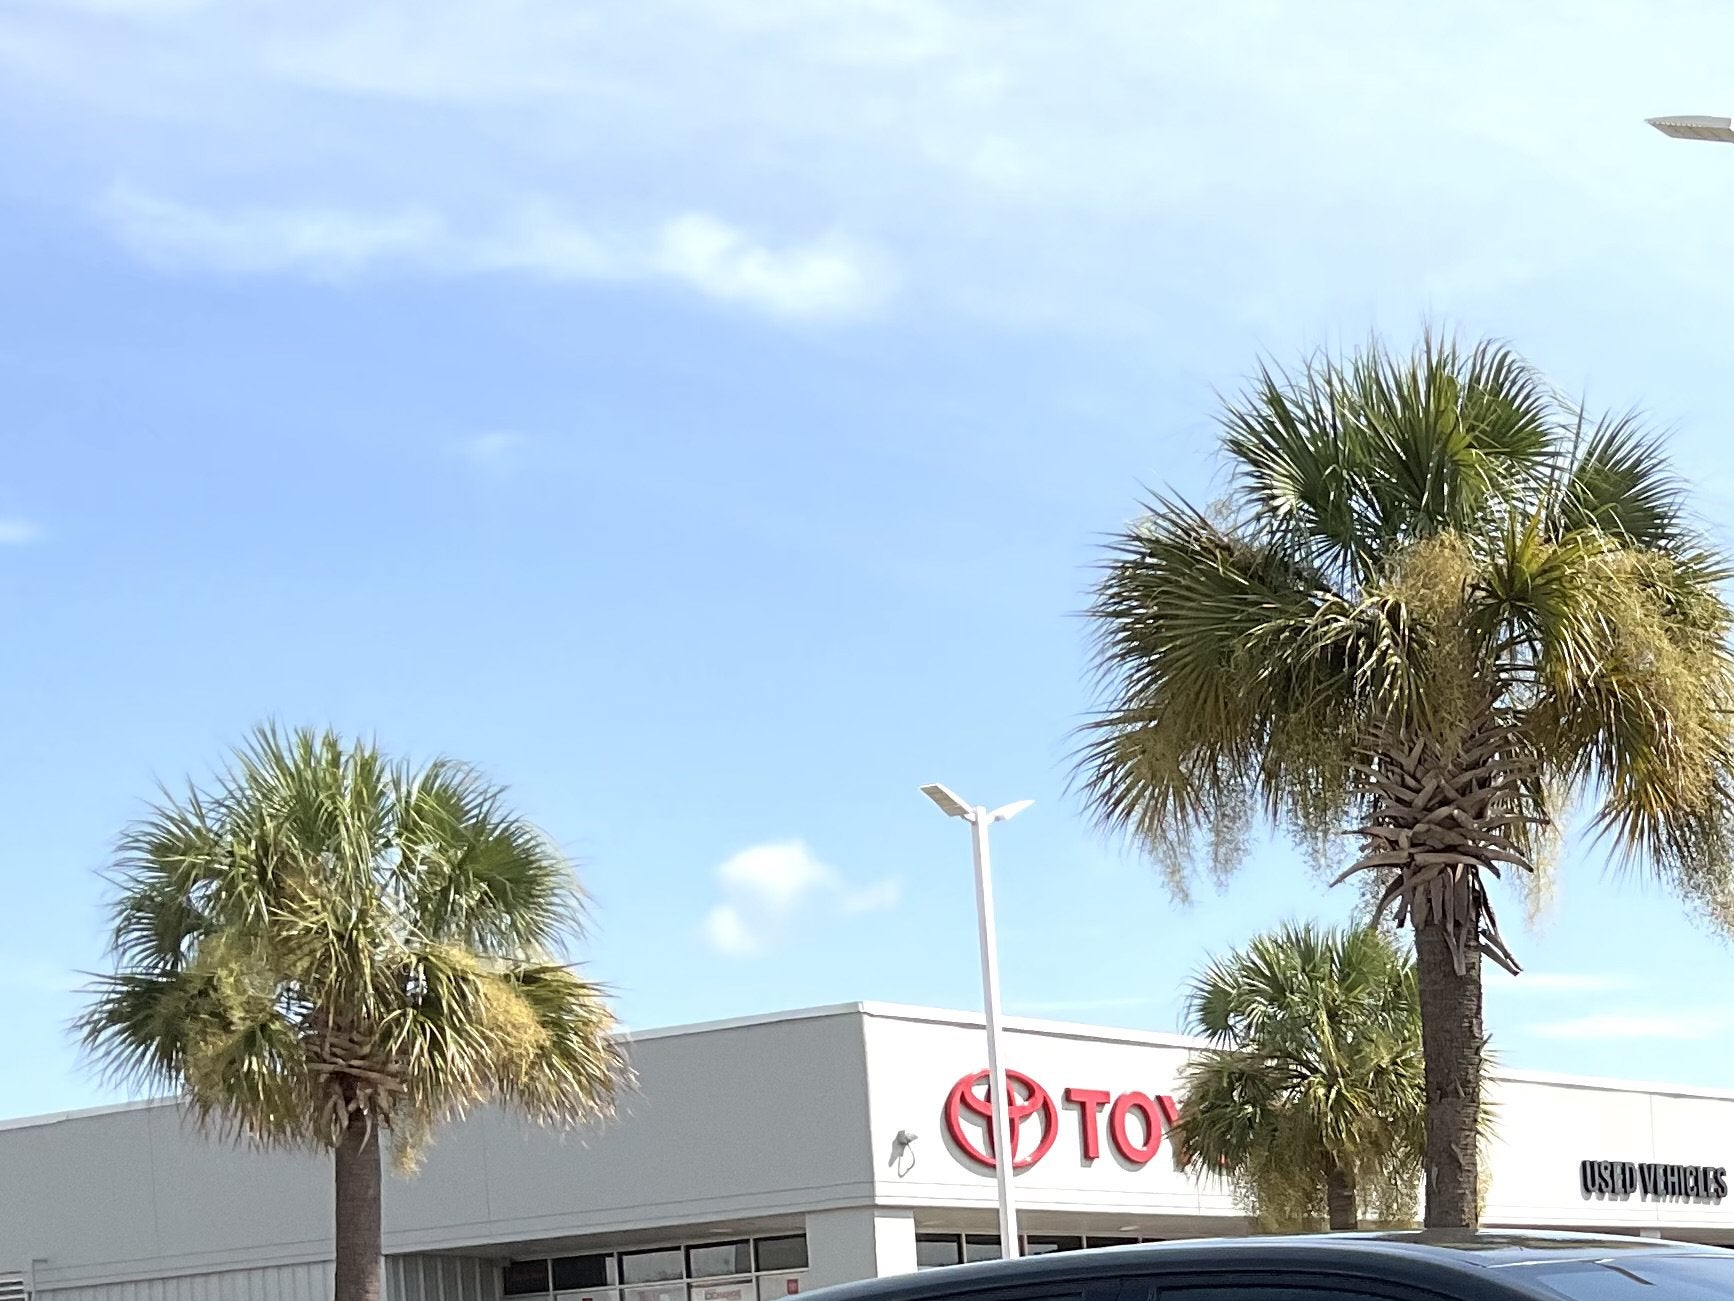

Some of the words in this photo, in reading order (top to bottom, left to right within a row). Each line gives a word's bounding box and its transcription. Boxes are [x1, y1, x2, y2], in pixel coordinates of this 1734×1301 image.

[1064, 1087, 1198, 1170] TOY
[1579, 1160, 1637, 1195] USED
[1637, 1163, 1728, 1199] VEHICLES
